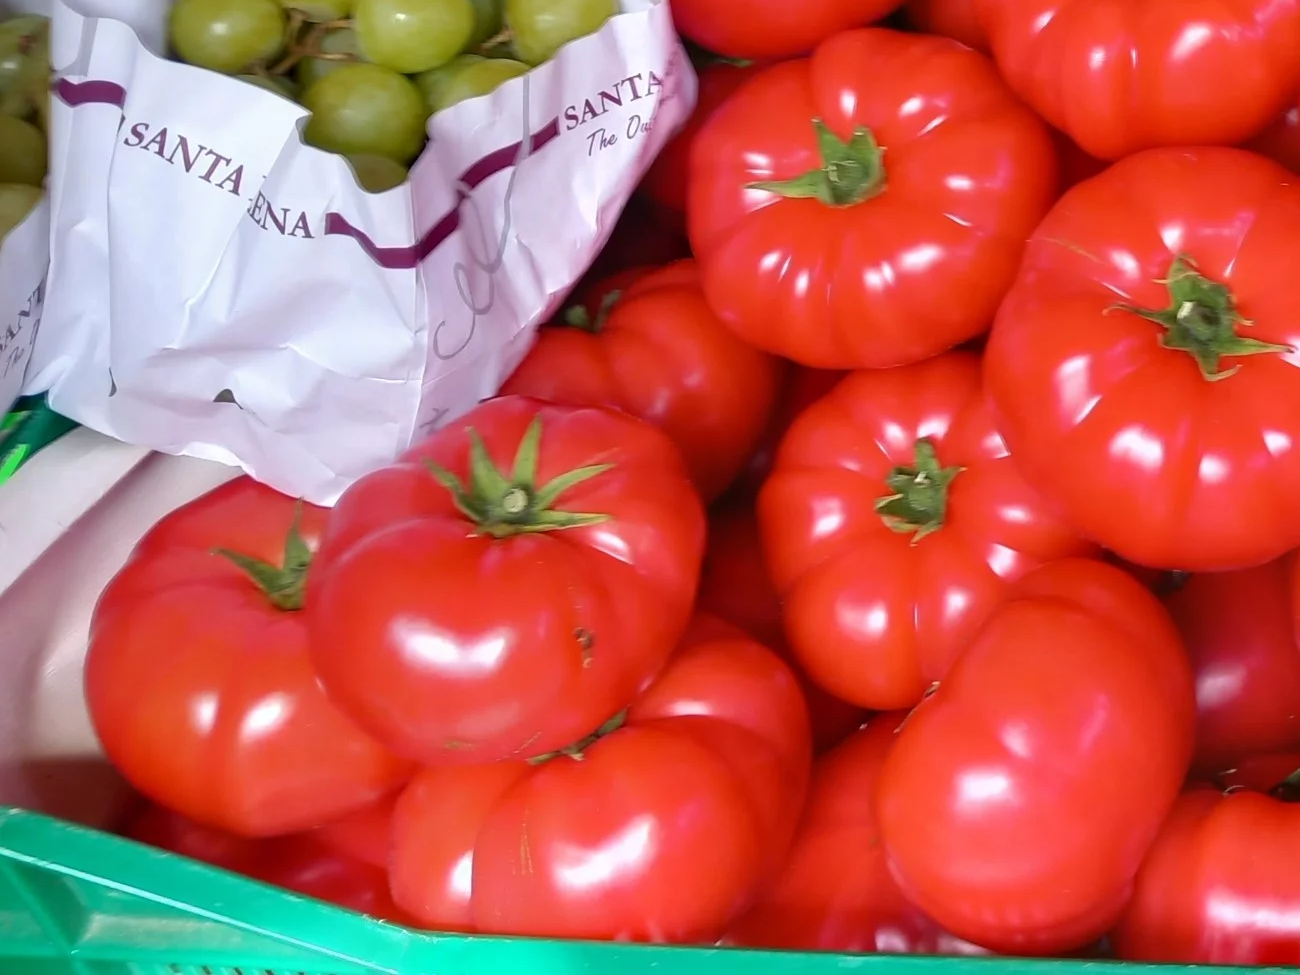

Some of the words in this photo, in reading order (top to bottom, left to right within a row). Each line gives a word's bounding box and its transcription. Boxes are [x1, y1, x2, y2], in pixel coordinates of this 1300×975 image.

[563, 70, 664, 132] SANTA
[586, 127, 618, 157] The
[123, 121, 245, 197] SANTA
[247, 175, 316, 239] ENA
